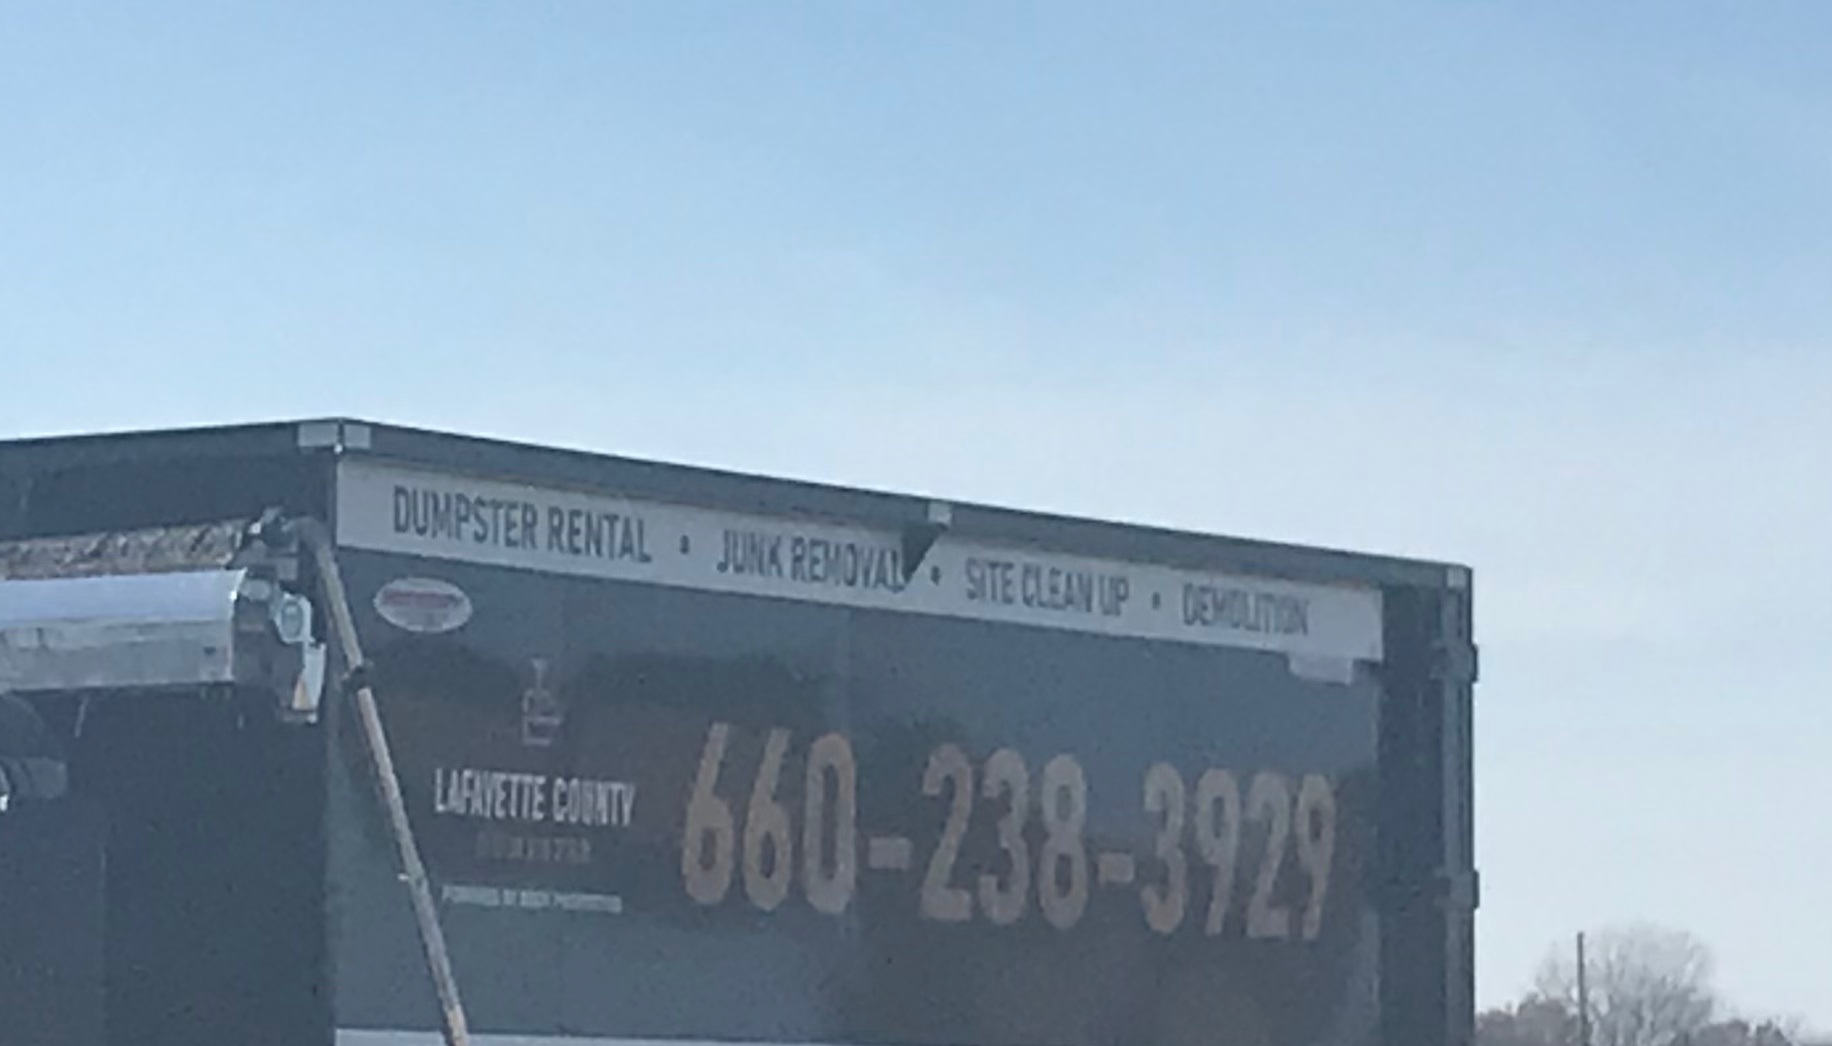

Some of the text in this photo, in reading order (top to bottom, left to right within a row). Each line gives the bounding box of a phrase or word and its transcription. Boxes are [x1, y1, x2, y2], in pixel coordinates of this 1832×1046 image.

[393, 484, 1310, 636] DUMPSTER RENTAL JUNK REMOVAL SITE CLEAN UP DEMOLITION
[434, 767, 636, 828] LAFAYETTE COUNTY
[681, 721, 1337, 941] 660-238-3929
